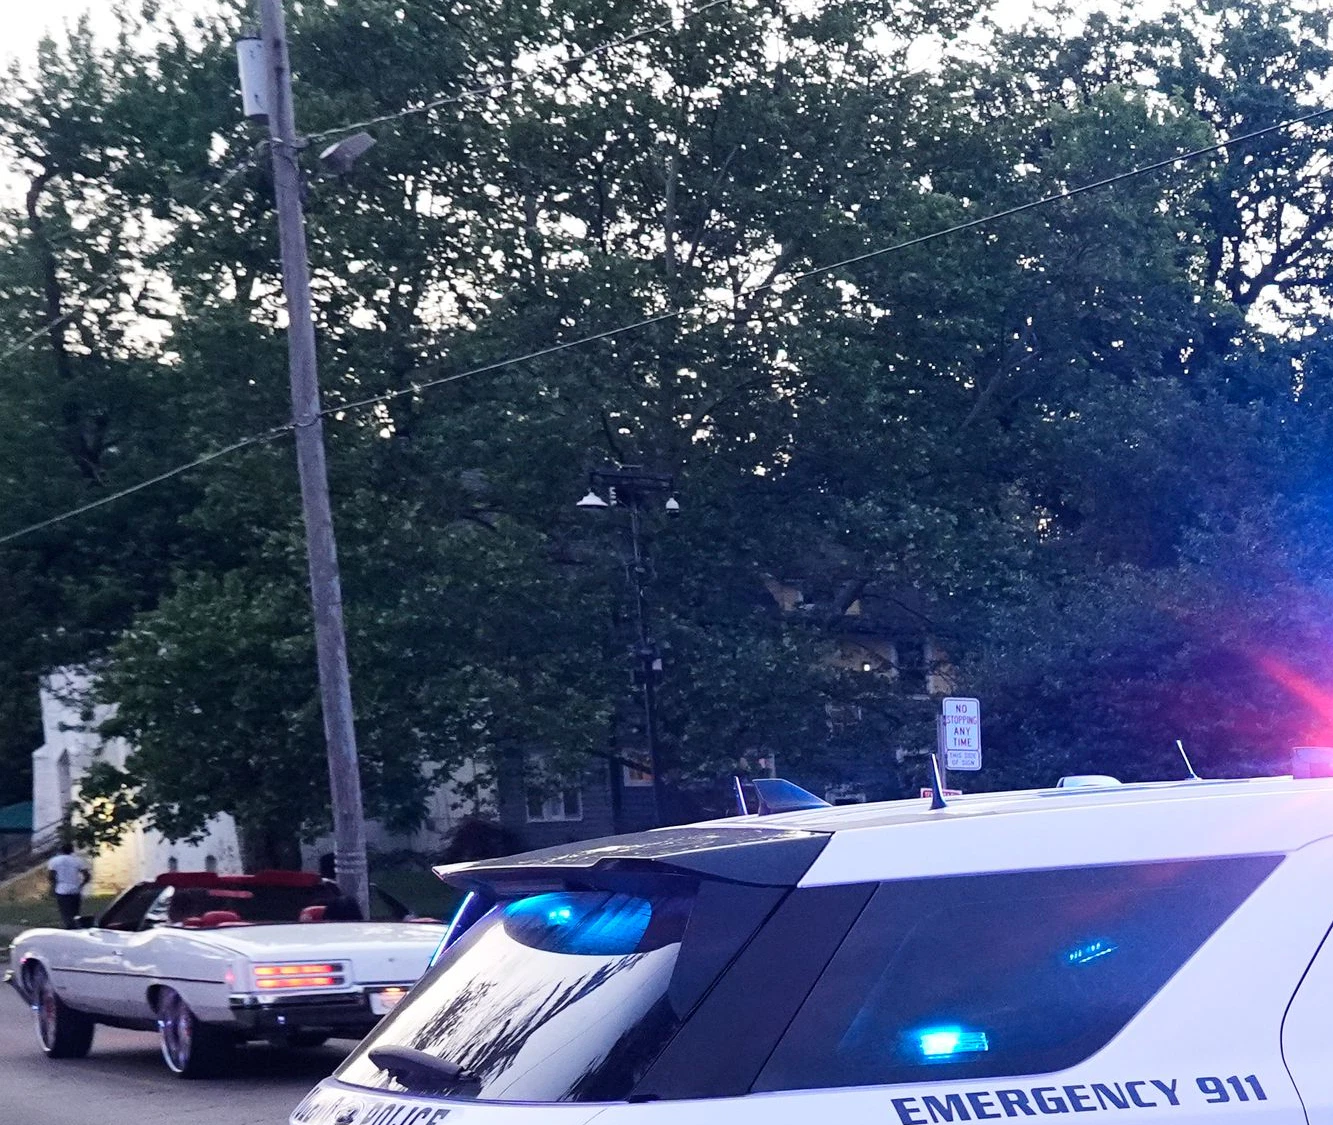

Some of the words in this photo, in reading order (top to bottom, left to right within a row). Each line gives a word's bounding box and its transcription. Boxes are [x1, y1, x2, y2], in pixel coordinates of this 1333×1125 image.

[955, 704, 968, 713] NO
[946, 715, 977, 724] STOPPING
[953, 727, 971, 736] ANY
[953, 738, 972, 747] TIME
[1195, 1074, 1268, 1104] 911
